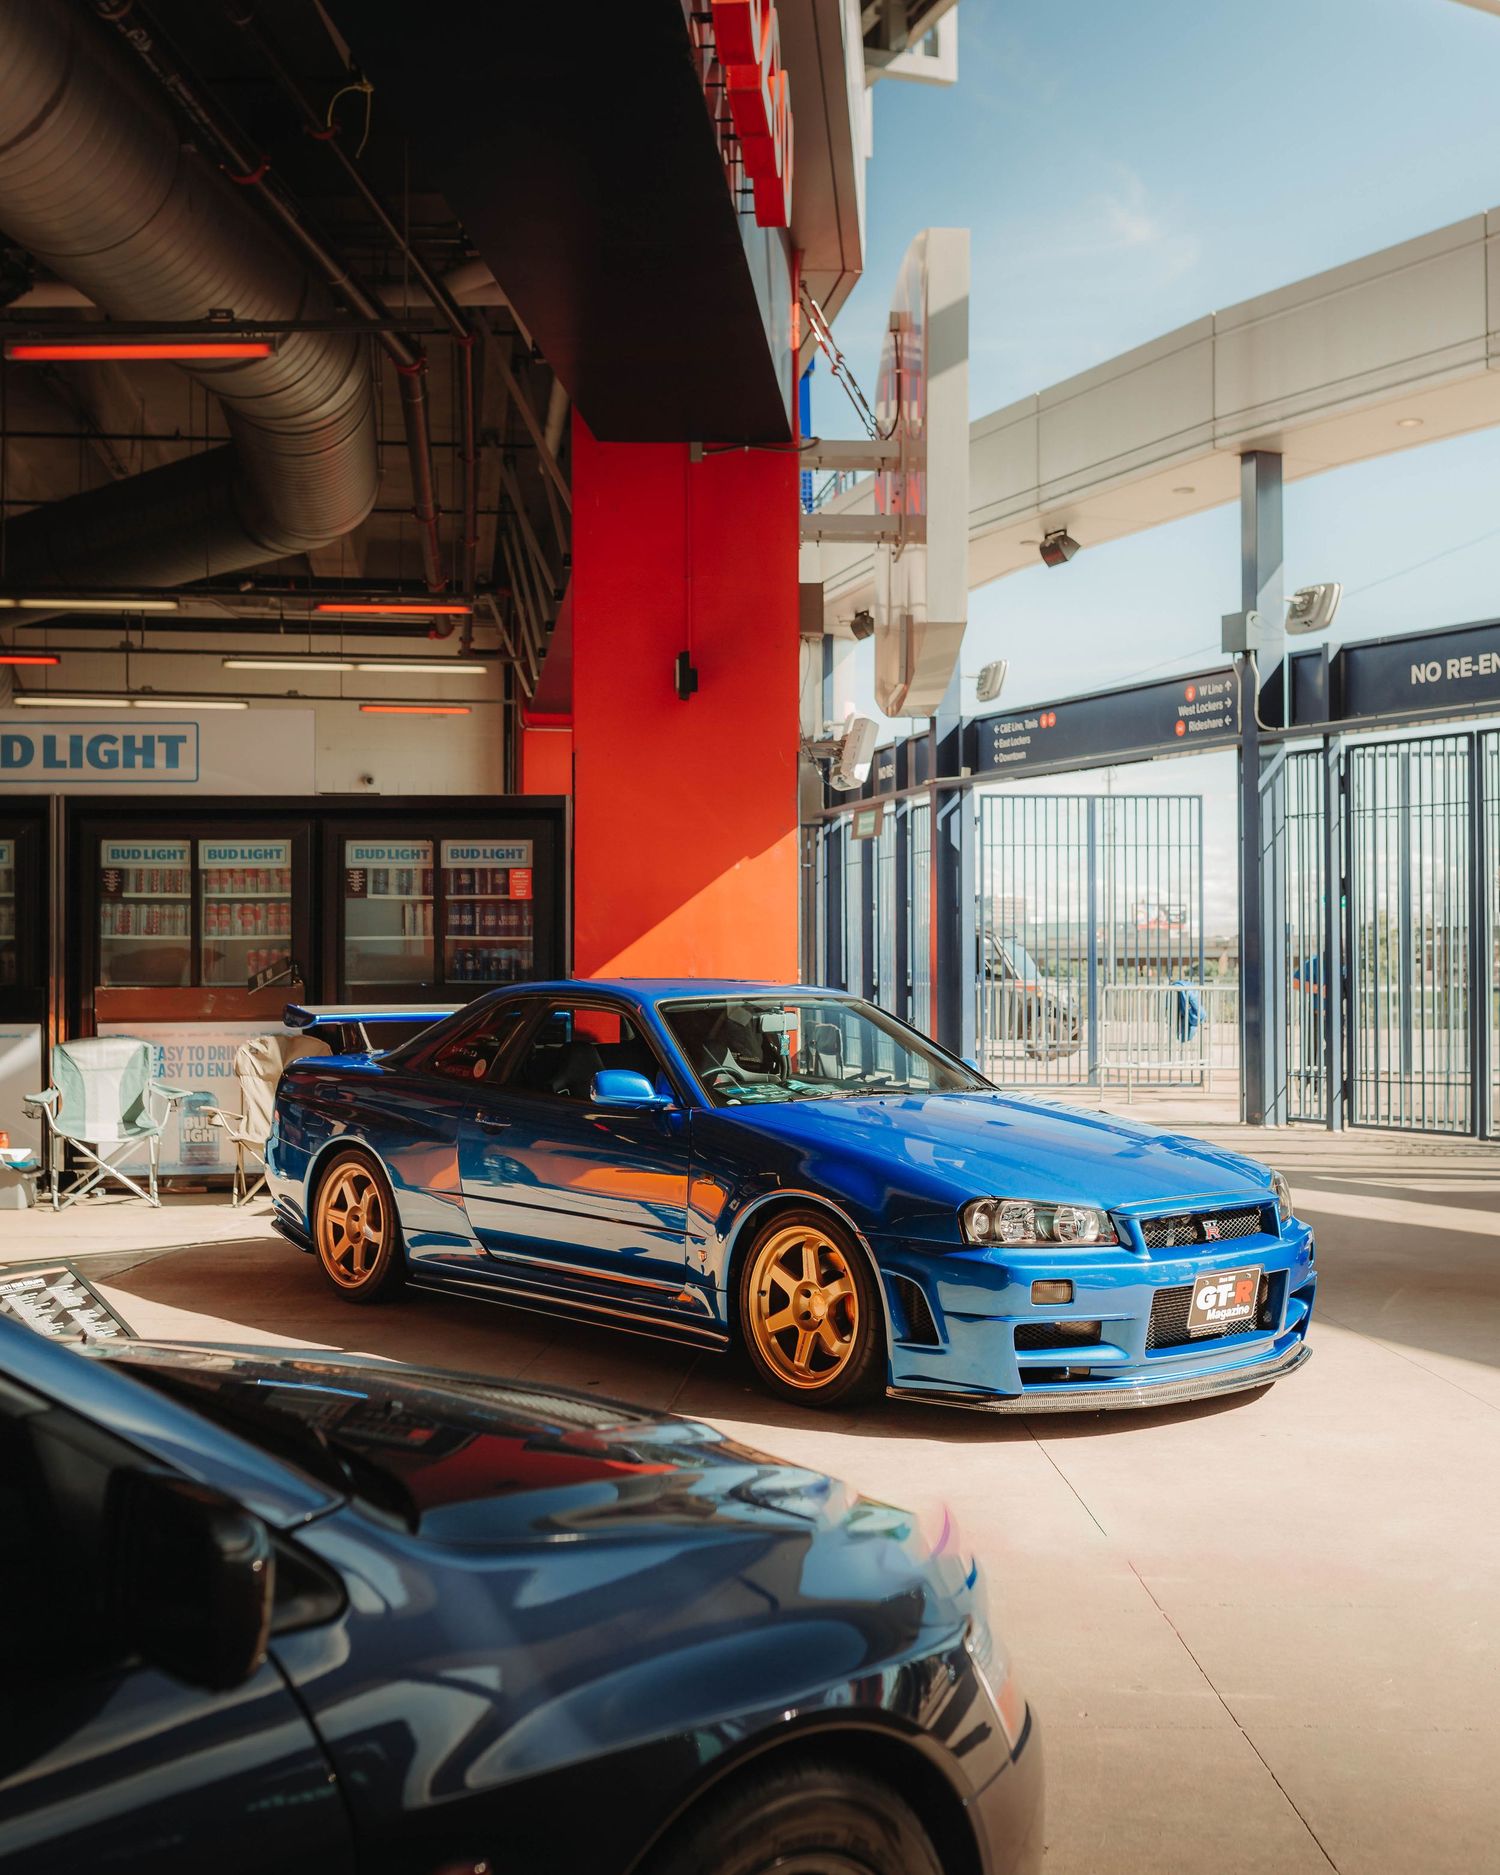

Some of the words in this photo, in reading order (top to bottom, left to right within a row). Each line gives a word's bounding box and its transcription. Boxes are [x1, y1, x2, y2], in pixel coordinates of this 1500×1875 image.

[1411, 661, 1442, 685] NO
[1199, 686, 1208, 696] W
[1208, 684, 1223, 695] Line
[1178, 704, 1196, 716] West
[1196, 700, 1224, 714] Lockers
[1189, 718, 1224, 732] Rideshare
[43, 734, 187, 770] LIGHT
[999, 751, 1027, 763] Downtown
[110, 848, 142, 860] BUD
[144, 848, 186, 860] LIGHT
[207, 848, 238, 860] BUD
[240, 848, 283, 860] LIGHT
[355, 848, 386, 860] BUD
[388, 848, 430, 860] LIGHT
[450, 848, 480, 860] BUD
[483, 848, 525, 860] LIGHT
[187, 1046, 205, 1060] TO
[208, 1046, 239, 1061] DRIN
[187, 1063, 204, 1077] TO
[208, 1063, 237, 1077] ENJ
[1196, 1279, 1254, 1310] GT-R
[1206, 1305, 1250, 1321] Magazine
